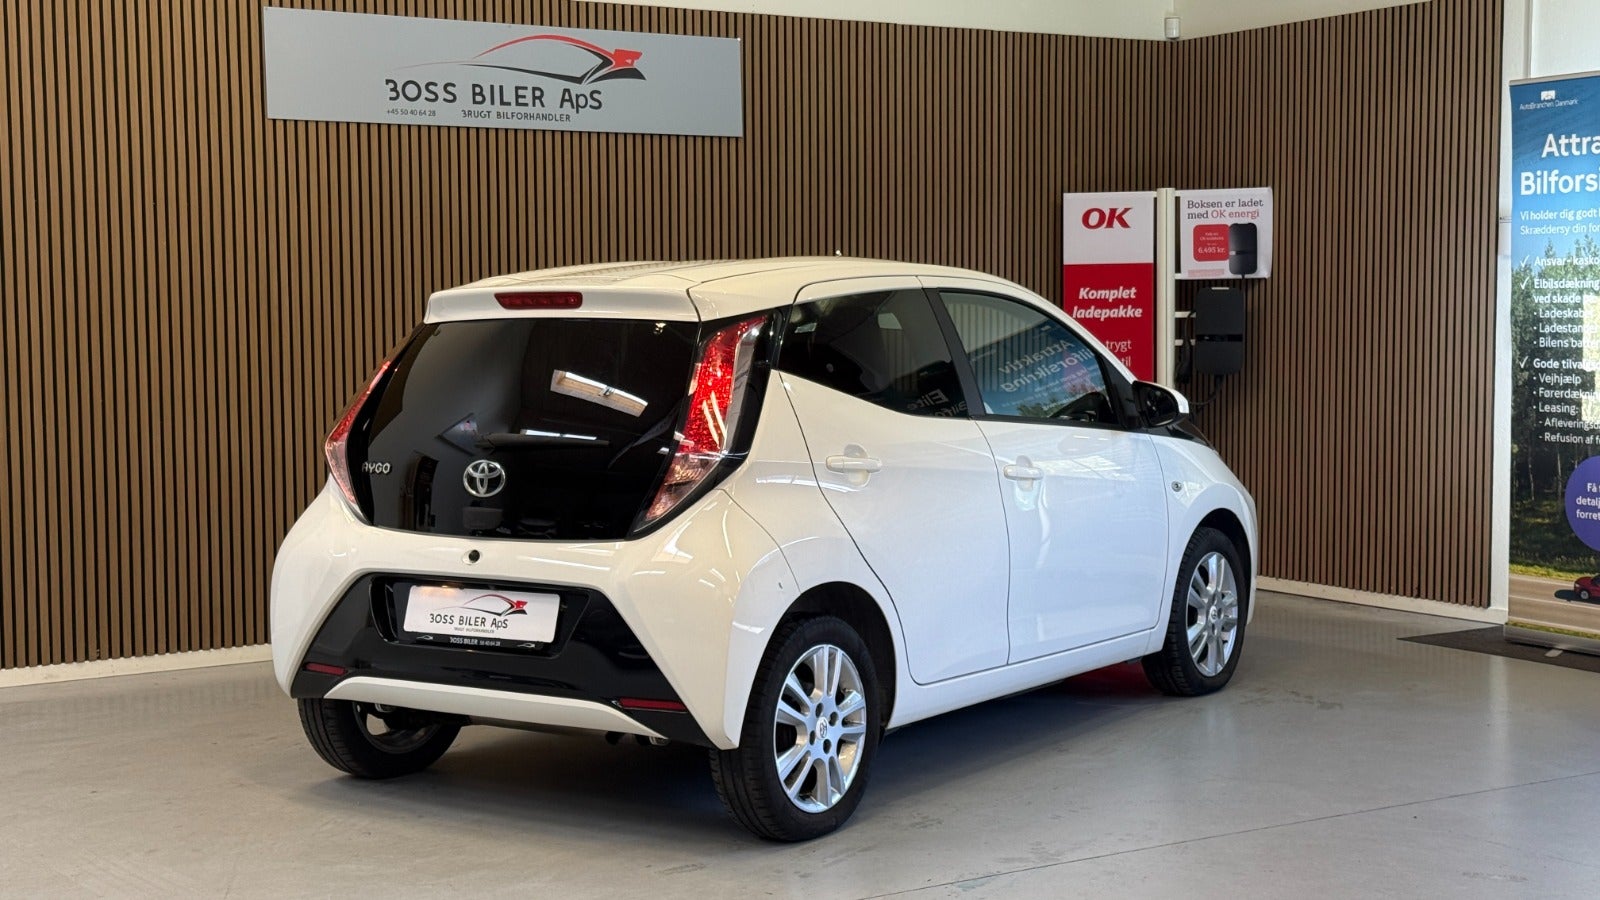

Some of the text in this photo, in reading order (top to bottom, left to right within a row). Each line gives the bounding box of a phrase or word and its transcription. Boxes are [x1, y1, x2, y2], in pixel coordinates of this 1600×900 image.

[471, 83, 546, 108] BILER
[559, 88, 604, 114] ApS
[386, 108, 437, 118] +45 50 40 64 28
[496, 111, 571, 122] BILFORHANDLER
[1187, 200, 1222, 209] Boksen
[1238, 198, 1264, 207] ladet
[1081, 207, 1133, 229] OK
[1187, 209, 1259, 219] med OK energi
[1520, 210, 1529, 220] Vi
[1530, 209, 1557, 220] holder
[1560, 208, 1574, 221] dig
[1576, 207, 1598, 221] godt
[1572, 223, 1587, 233] din
[1079, 287, 1137, 302] Komplet
[1534, 293, 1551, 303] ved
[1552, 293, 1581, 304] skade
[1073, 305, 1143, 321] ladepakke
[1539, 337, 1569, 348] Bilens
[1533, 358, 1559, 369] Gode
[1539, 373, 1582, 386] Vejhjælp
[1544, 432, 1583, 444] Refusion
[1584, 435, 1594, 445] af
[362, 462, 391, 474] AYGO
[458, 615, 486, 627] BILER
[490, 617, 509, 631] ApS
